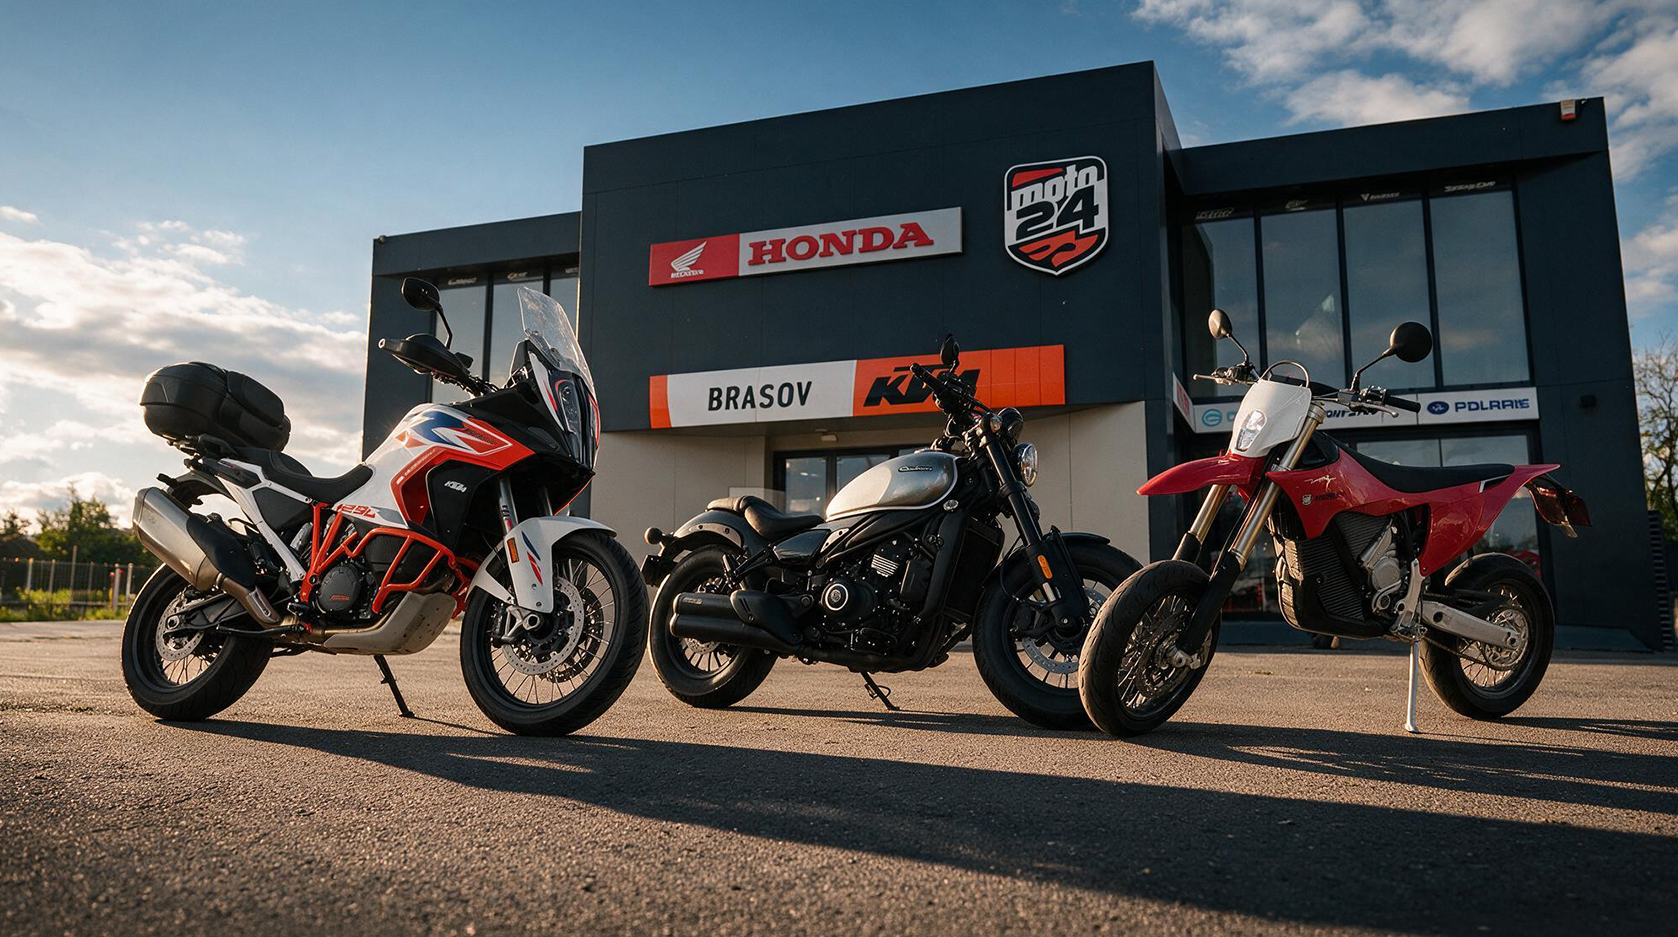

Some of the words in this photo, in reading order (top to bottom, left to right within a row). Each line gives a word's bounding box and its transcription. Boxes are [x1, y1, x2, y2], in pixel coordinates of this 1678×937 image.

[1011, 164, 1098, 211] moto
[1015, 184, 1100, 242] 24
[747, 222, 934, 267] HONDA
[707, 380, 813, 412] BRASOV
